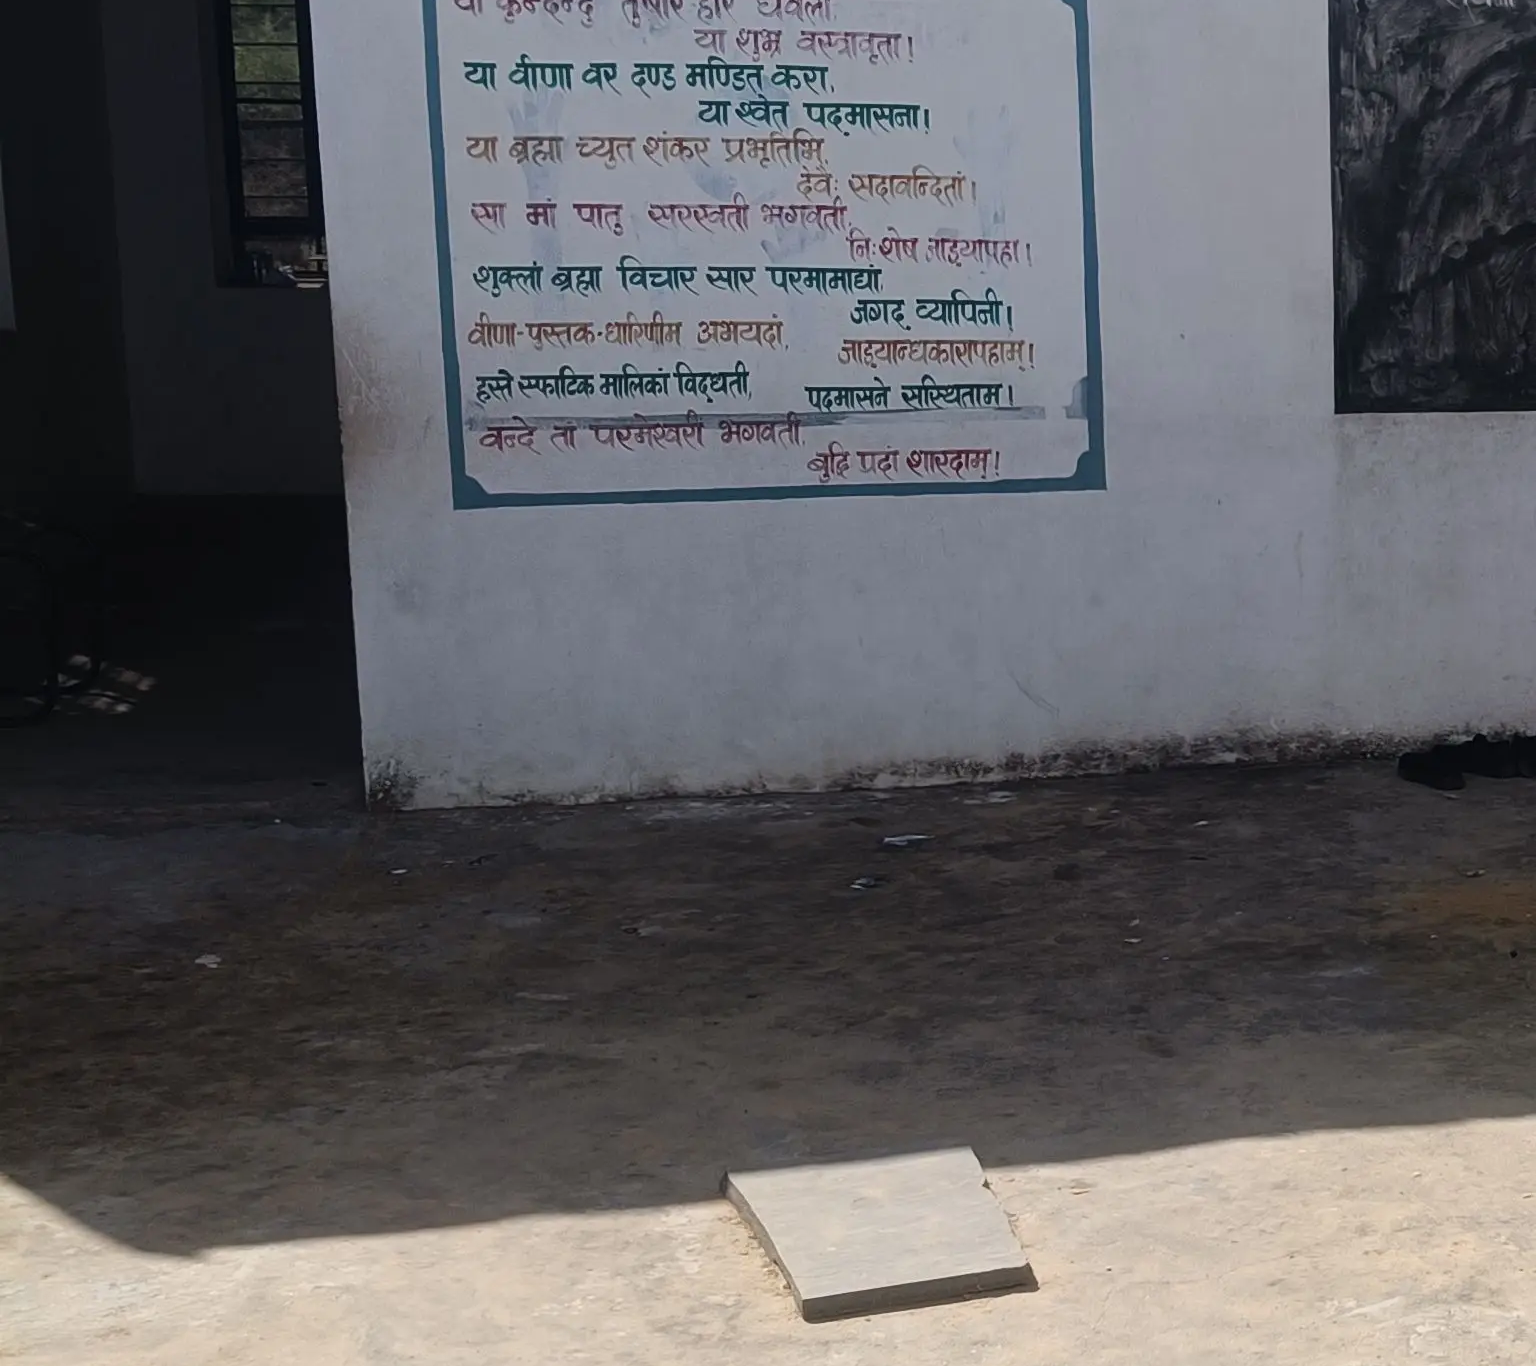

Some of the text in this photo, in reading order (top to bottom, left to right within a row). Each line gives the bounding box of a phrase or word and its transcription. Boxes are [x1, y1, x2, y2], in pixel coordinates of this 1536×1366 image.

[694, 29, 727, 54] या
[463, 61, 497, 91] या
[508, 54, 574, 91] वीणा
[581, 62, 622, 96] वर
[630, 63, 677, 98] दण्ड
[685, 56, 765, 92] मण्डित
[698, 100, 731, 125] या
[735, 93, 790, 129] श्वेत
[465, 136, 498, 163] या
[642, 131, 711, 167] शंकर
[471, 202, 507, 235] सा
[525, 198, 558, 230] मां
[572, 202, 624, 236] पातु
[472, 261, 544, 298] शुक्लां
[616, 255, 700, 297] विचार
[705, 266, 759, 296] सार
[475, 369, 514, 408] हस्ते
[517, 365, 595, 399] स्फाटिक
[600, 363, 671, 399] मालिकां
[479, 415, 541, 455] वन्दे
[549, 420, 579, 450] तां
